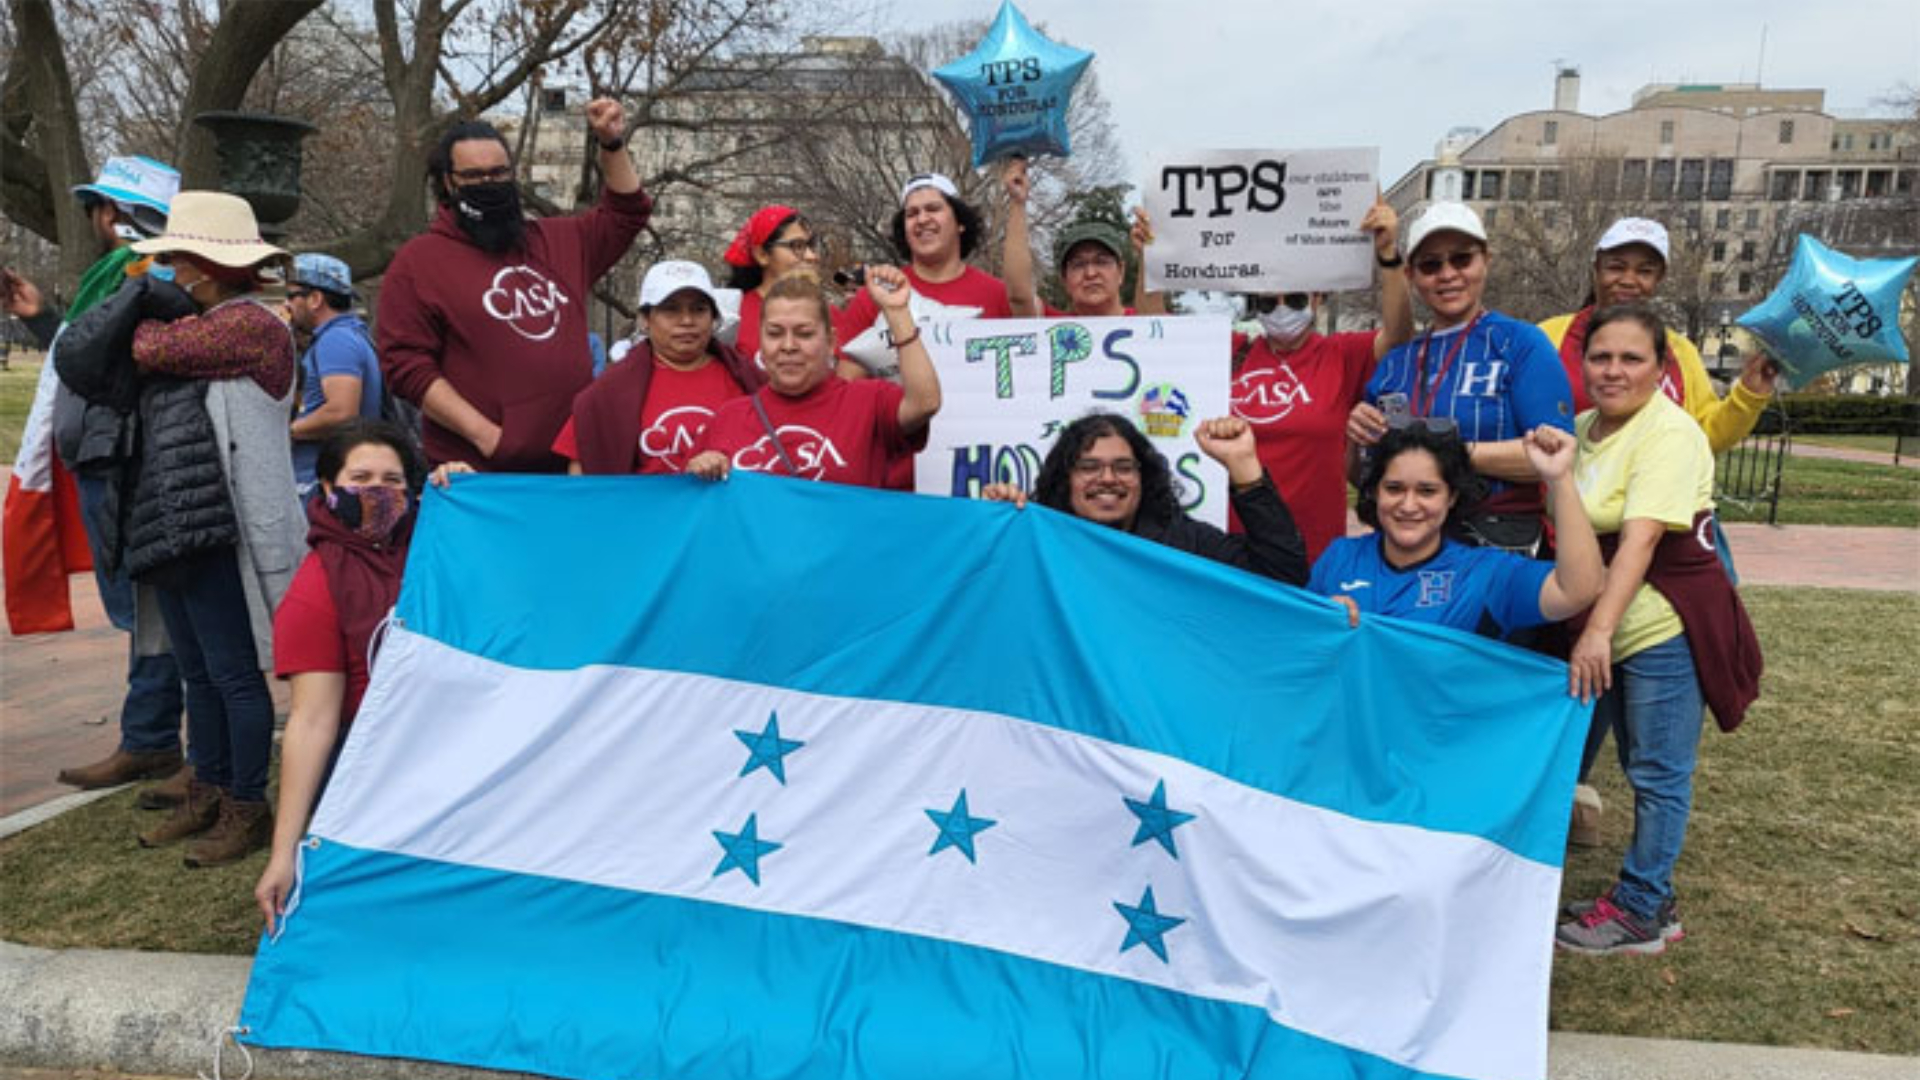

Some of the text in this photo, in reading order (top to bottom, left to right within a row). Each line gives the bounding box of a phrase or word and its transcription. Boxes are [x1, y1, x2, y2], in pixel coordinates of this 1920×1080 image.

[980, 56, 1042, 86] TPS
[1161, 159, 1287, 218] TPS
[1200, 230, 1236, 248] For
[1164, 262, 1265, 279] Honduras.
[1832, 280, 1882, 339] TPS
[1457, 360, 1503, 397] H
[1415, 570, 1454, 607] H
